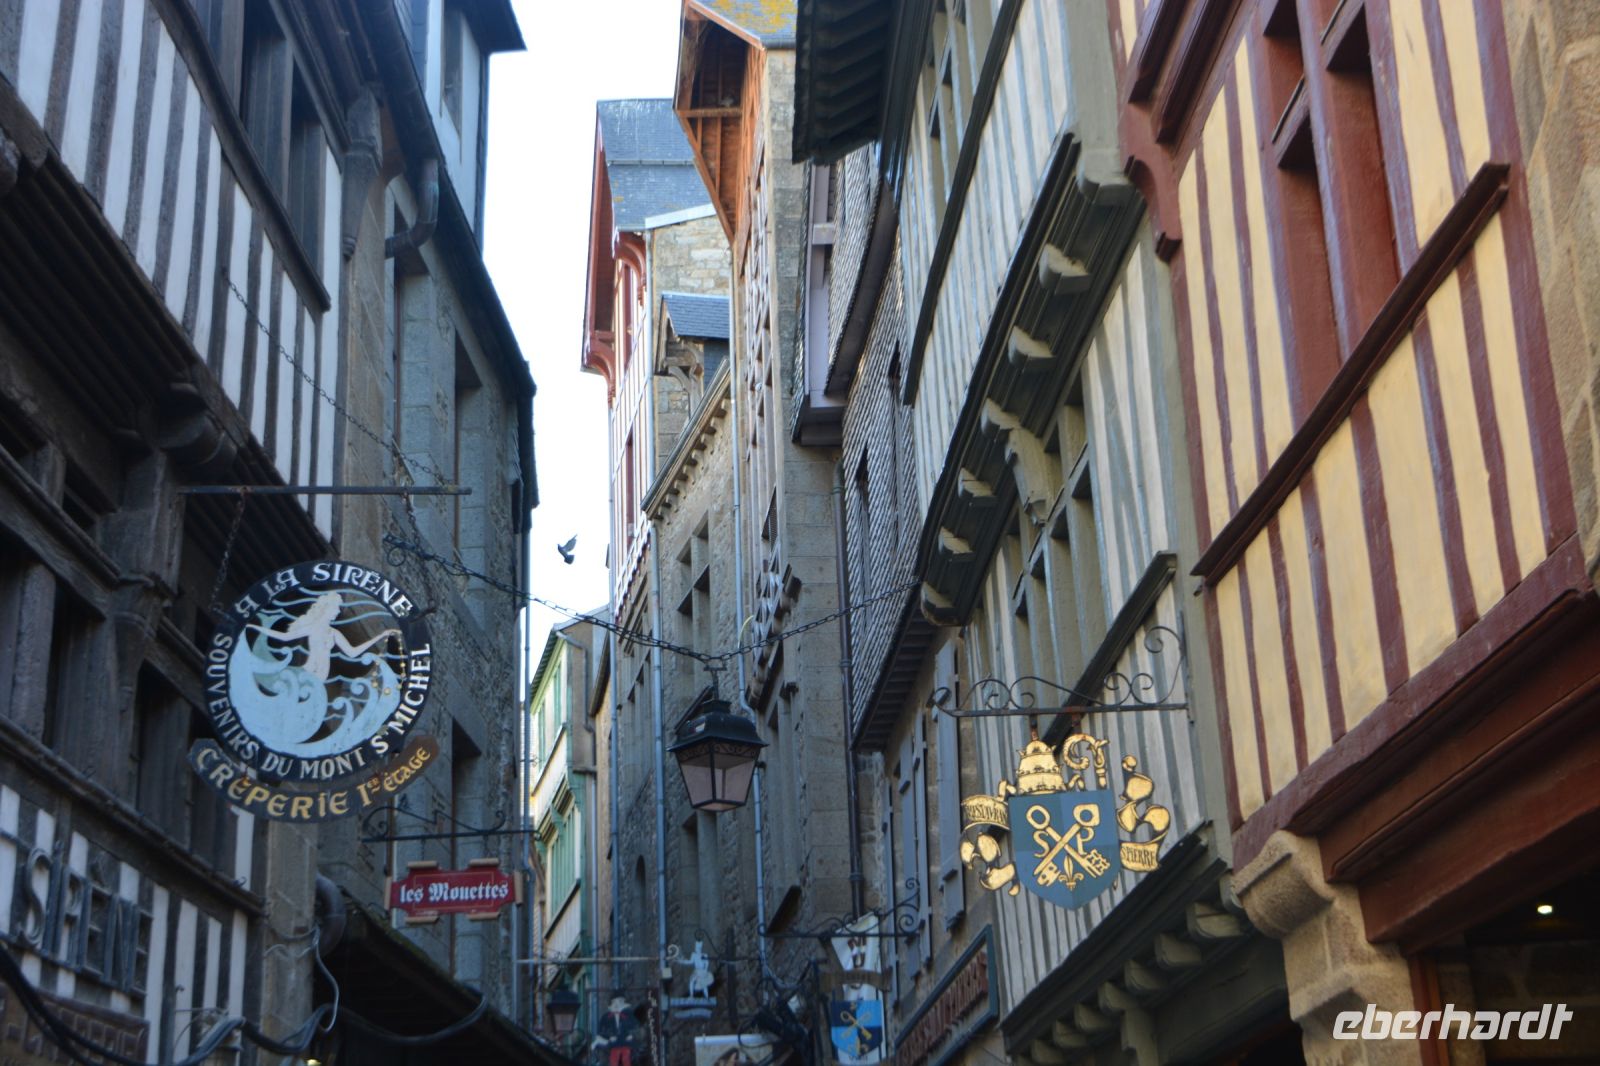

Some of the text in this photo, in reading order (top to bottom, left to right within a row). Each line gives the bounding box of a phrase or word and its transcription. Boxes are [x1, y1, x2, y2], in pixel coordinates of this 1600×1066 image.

[234, 593, 261, 619] A
[261, 568, 301, 601] LA
[206, 633, 261, 760] SOUVENIRS
[260, 751, 295, 777] DU
[299, 746, 367, 780] MONT
[387, 642, 432, 736] MICHEL
[399, 881, 509, 904] les Mouettes
